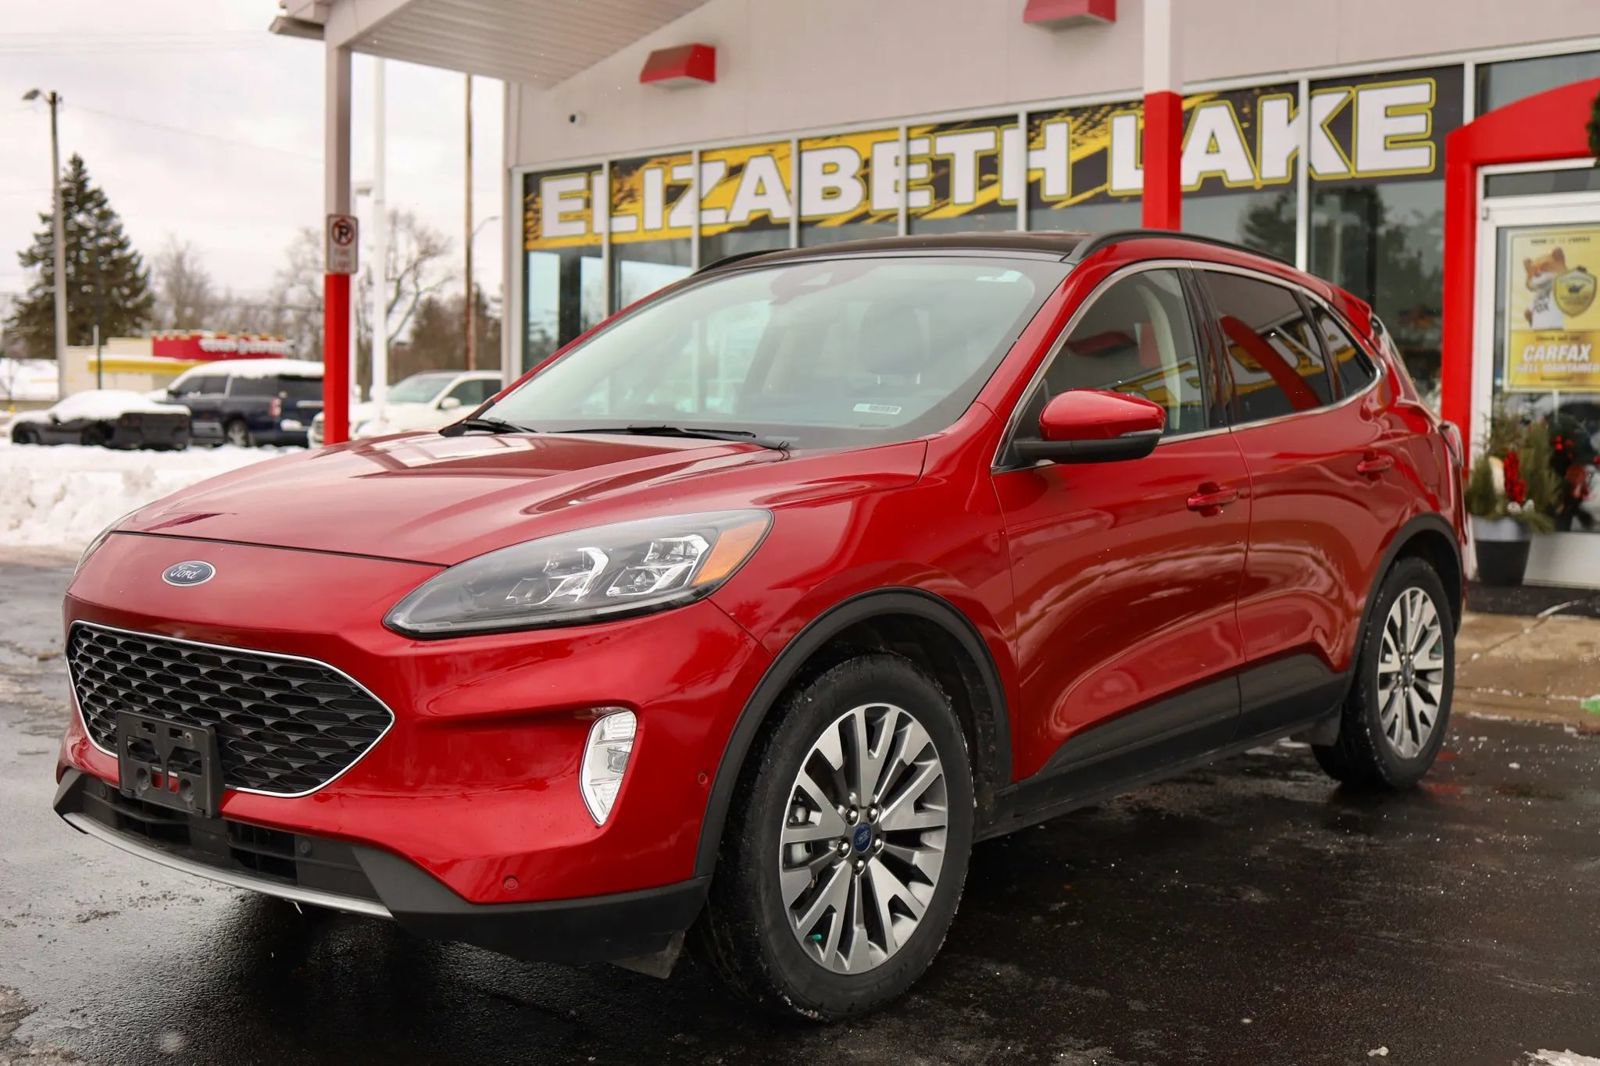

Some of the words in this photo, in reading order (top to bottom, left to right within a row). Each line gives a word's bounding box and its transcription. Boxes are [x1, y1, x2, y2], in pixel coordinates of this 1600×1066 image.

[540, 117, 1071, 239] ELIZABETH
[1107, 78, 1436, 197] LAKE
[1523, 343, 1593, 362] CARFAX
[169, 563, 203, 580] Ford
